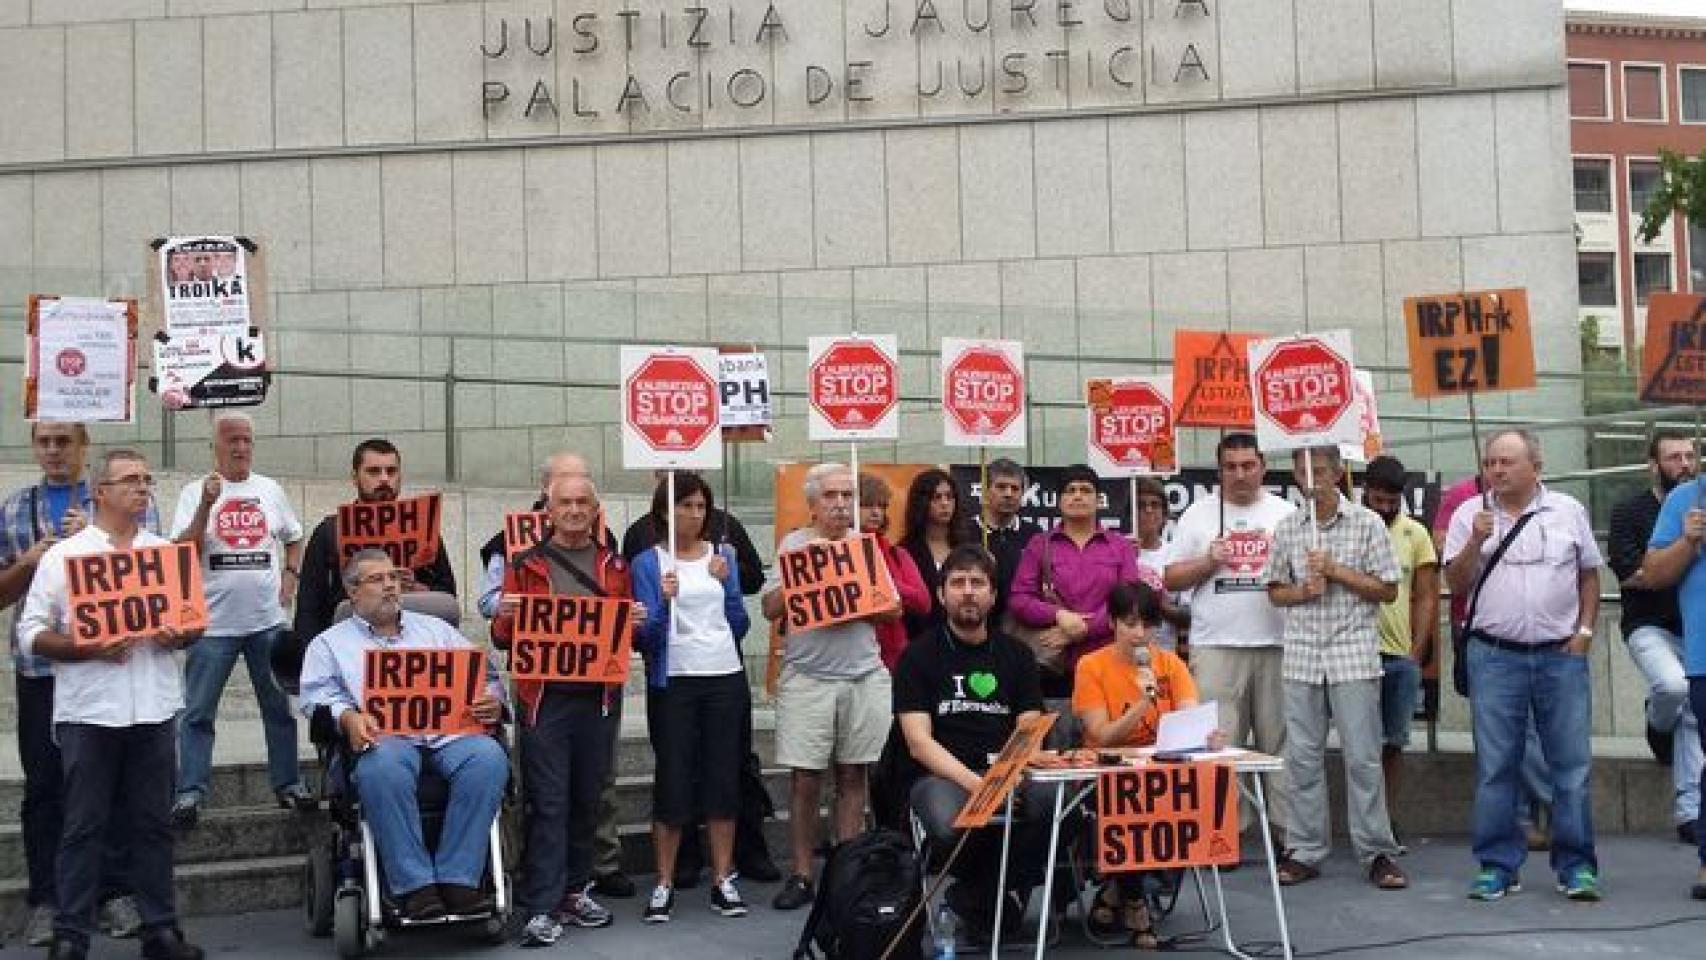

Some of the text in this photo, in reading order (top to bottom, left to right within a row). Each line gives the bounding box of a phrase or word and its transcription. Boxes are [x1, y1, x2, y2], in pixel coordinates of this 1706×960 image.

[480, 3, 789, 58] JUSTIZIA
[482, 44, 1210, 118] PALACIO DE JUSTICIA
[637, 391, 709, 416] STOP
[821, 376, 887, 396] STOP
[955, 379, 1015, 401] STOP
[1267, 373, 1340, 401] STOP
[1101, 415, 1166, 436] STOP
[219, 511, 262, 529] STOP
[340, 497, 418, 536] IRPH
[68, 548, 164, 596] IRPH
[343, 540, 418, 568] OP
[779, 542, 856, 589] IRPH
[75, 594, 169, 640] STOP
[518, 597, 603, 635] IRPH
[788, 581, 862, 626] STOP
[367, 651, 455, 688] IRPH
[514, 639, 598, 677] STOP
[366, 696, 452, 730] STOP
[1103, 768, 1199, 817] IRPH
[1104, 821, 1199, 865] STOP
